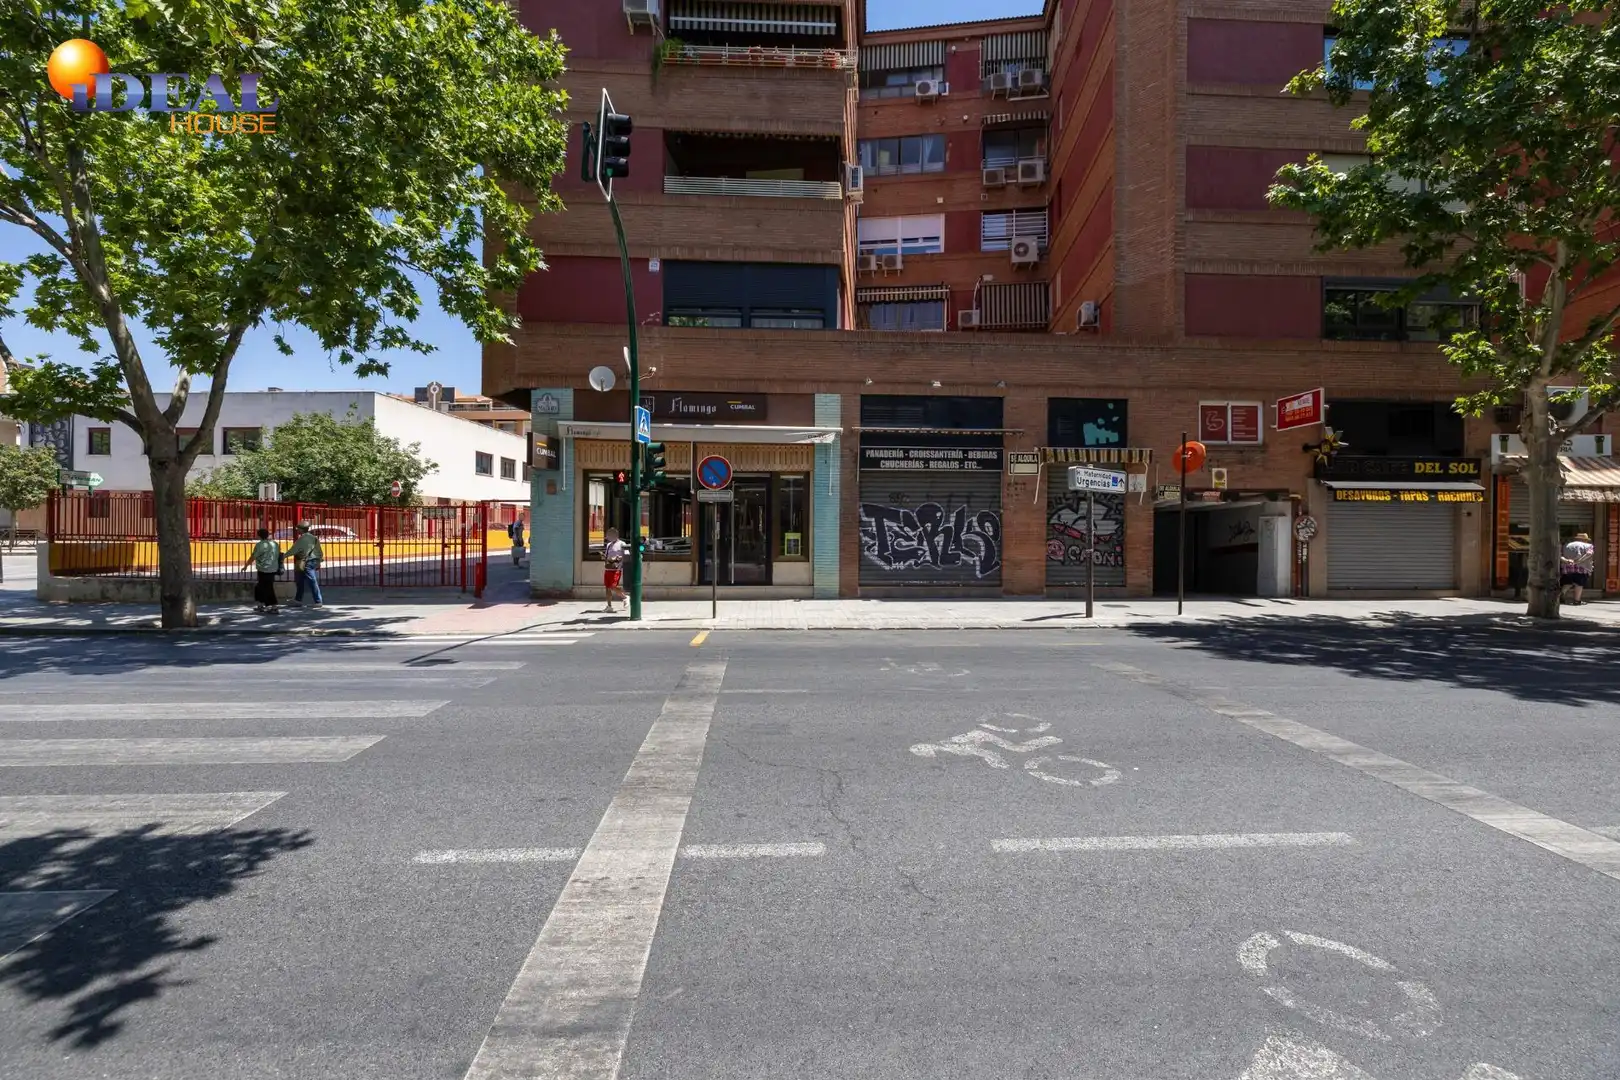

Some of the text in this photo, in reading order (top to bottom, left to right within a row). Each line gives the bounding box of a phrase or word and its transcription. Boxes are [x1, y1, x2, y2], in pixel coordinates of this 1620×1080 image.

[669, 397, 716, 414] Flamingo
[865, 449, 904, 459] PANADERÍA
[909, 449, 963, 459] CROISSANTERÍA
[968, 450, 998, 459] BEBIDAS
[1018, 455, 1038, 463] ALQUILA
[880, 459, 924, 469] CHUCHERÍAS
[929, 460, 959, 469] REGALOS
[1414, 462, 1443, 474] DEL
[1449, 462, 1478, 474] SOL
[1084, 470, 1112, 479] Maternidad
[1076, 478, 1111, 488] Urgencias
[1399, 491, 1429, 501] TAPAS
